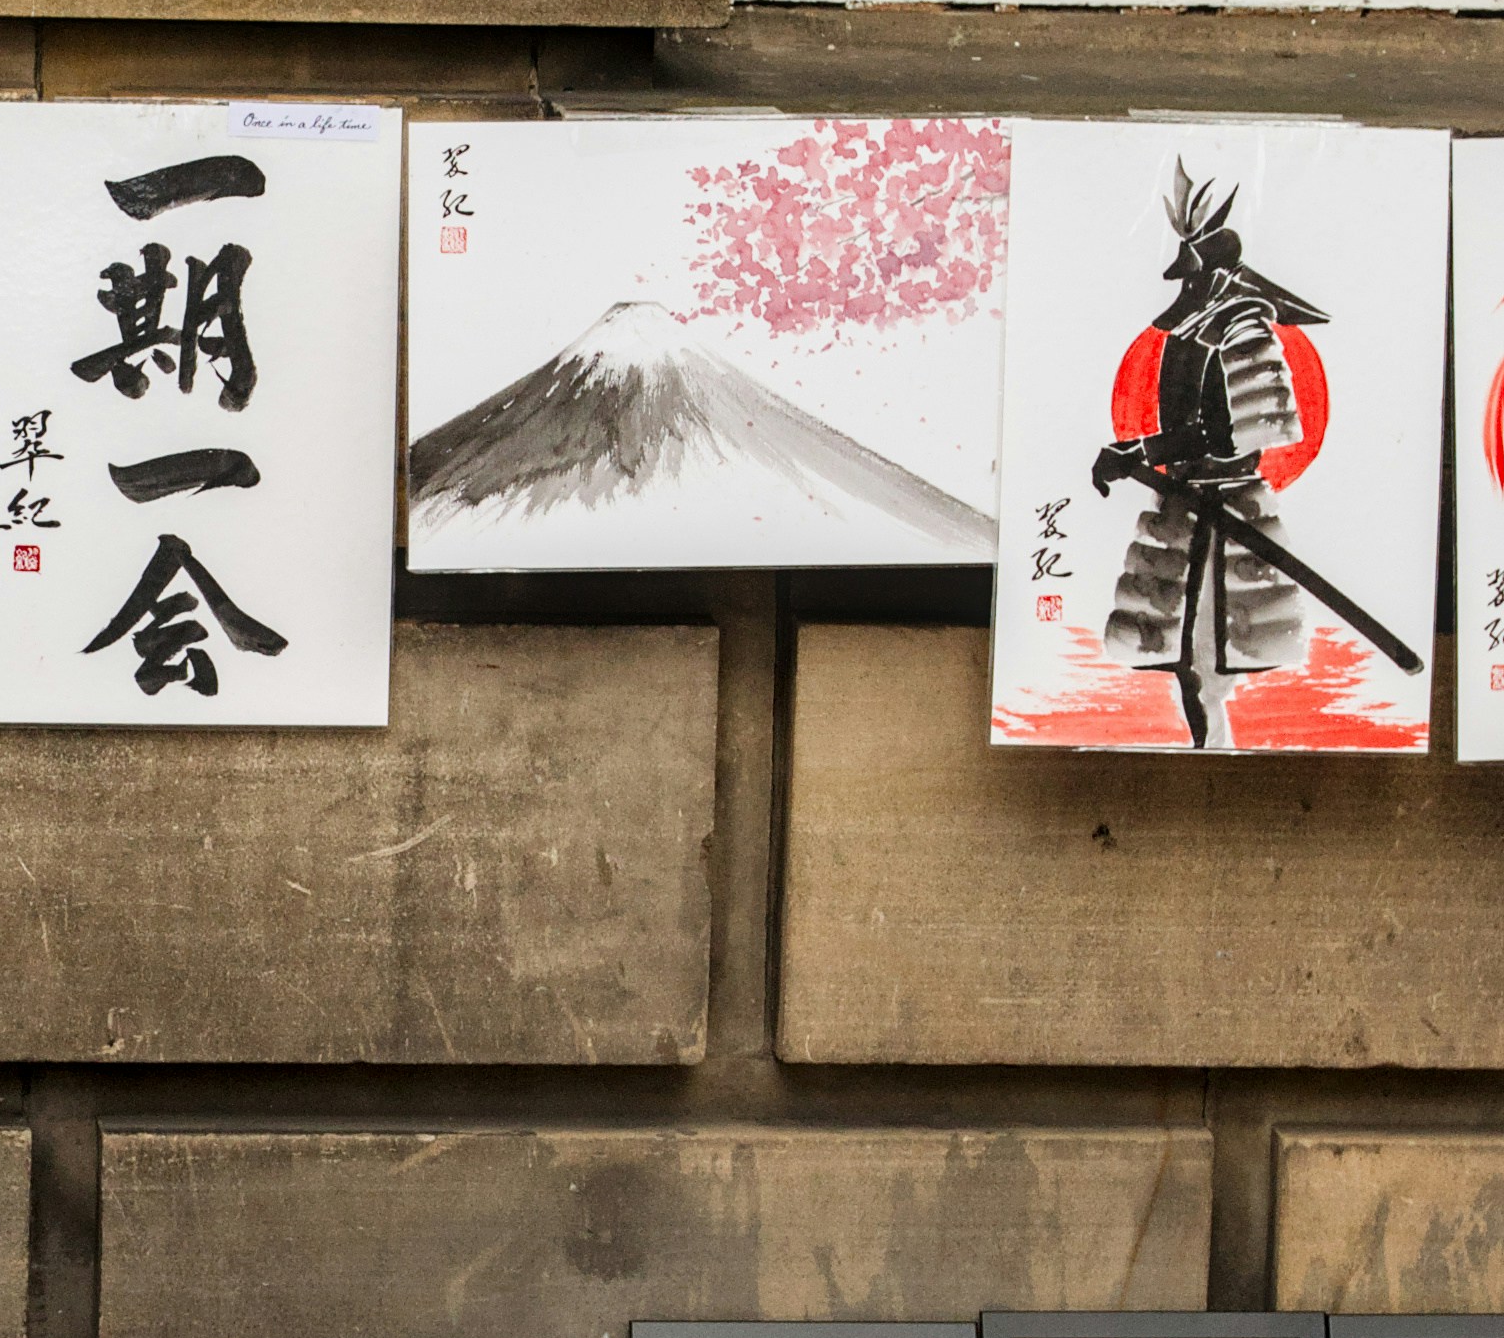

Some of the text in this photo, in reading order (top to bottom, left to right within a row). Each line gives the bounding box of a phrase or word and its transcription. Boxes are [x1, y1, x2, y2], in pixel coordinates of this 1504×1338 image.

[243, 112, 372, 134] Once in a life time
[69, 153, 290, 697] 一期一会
